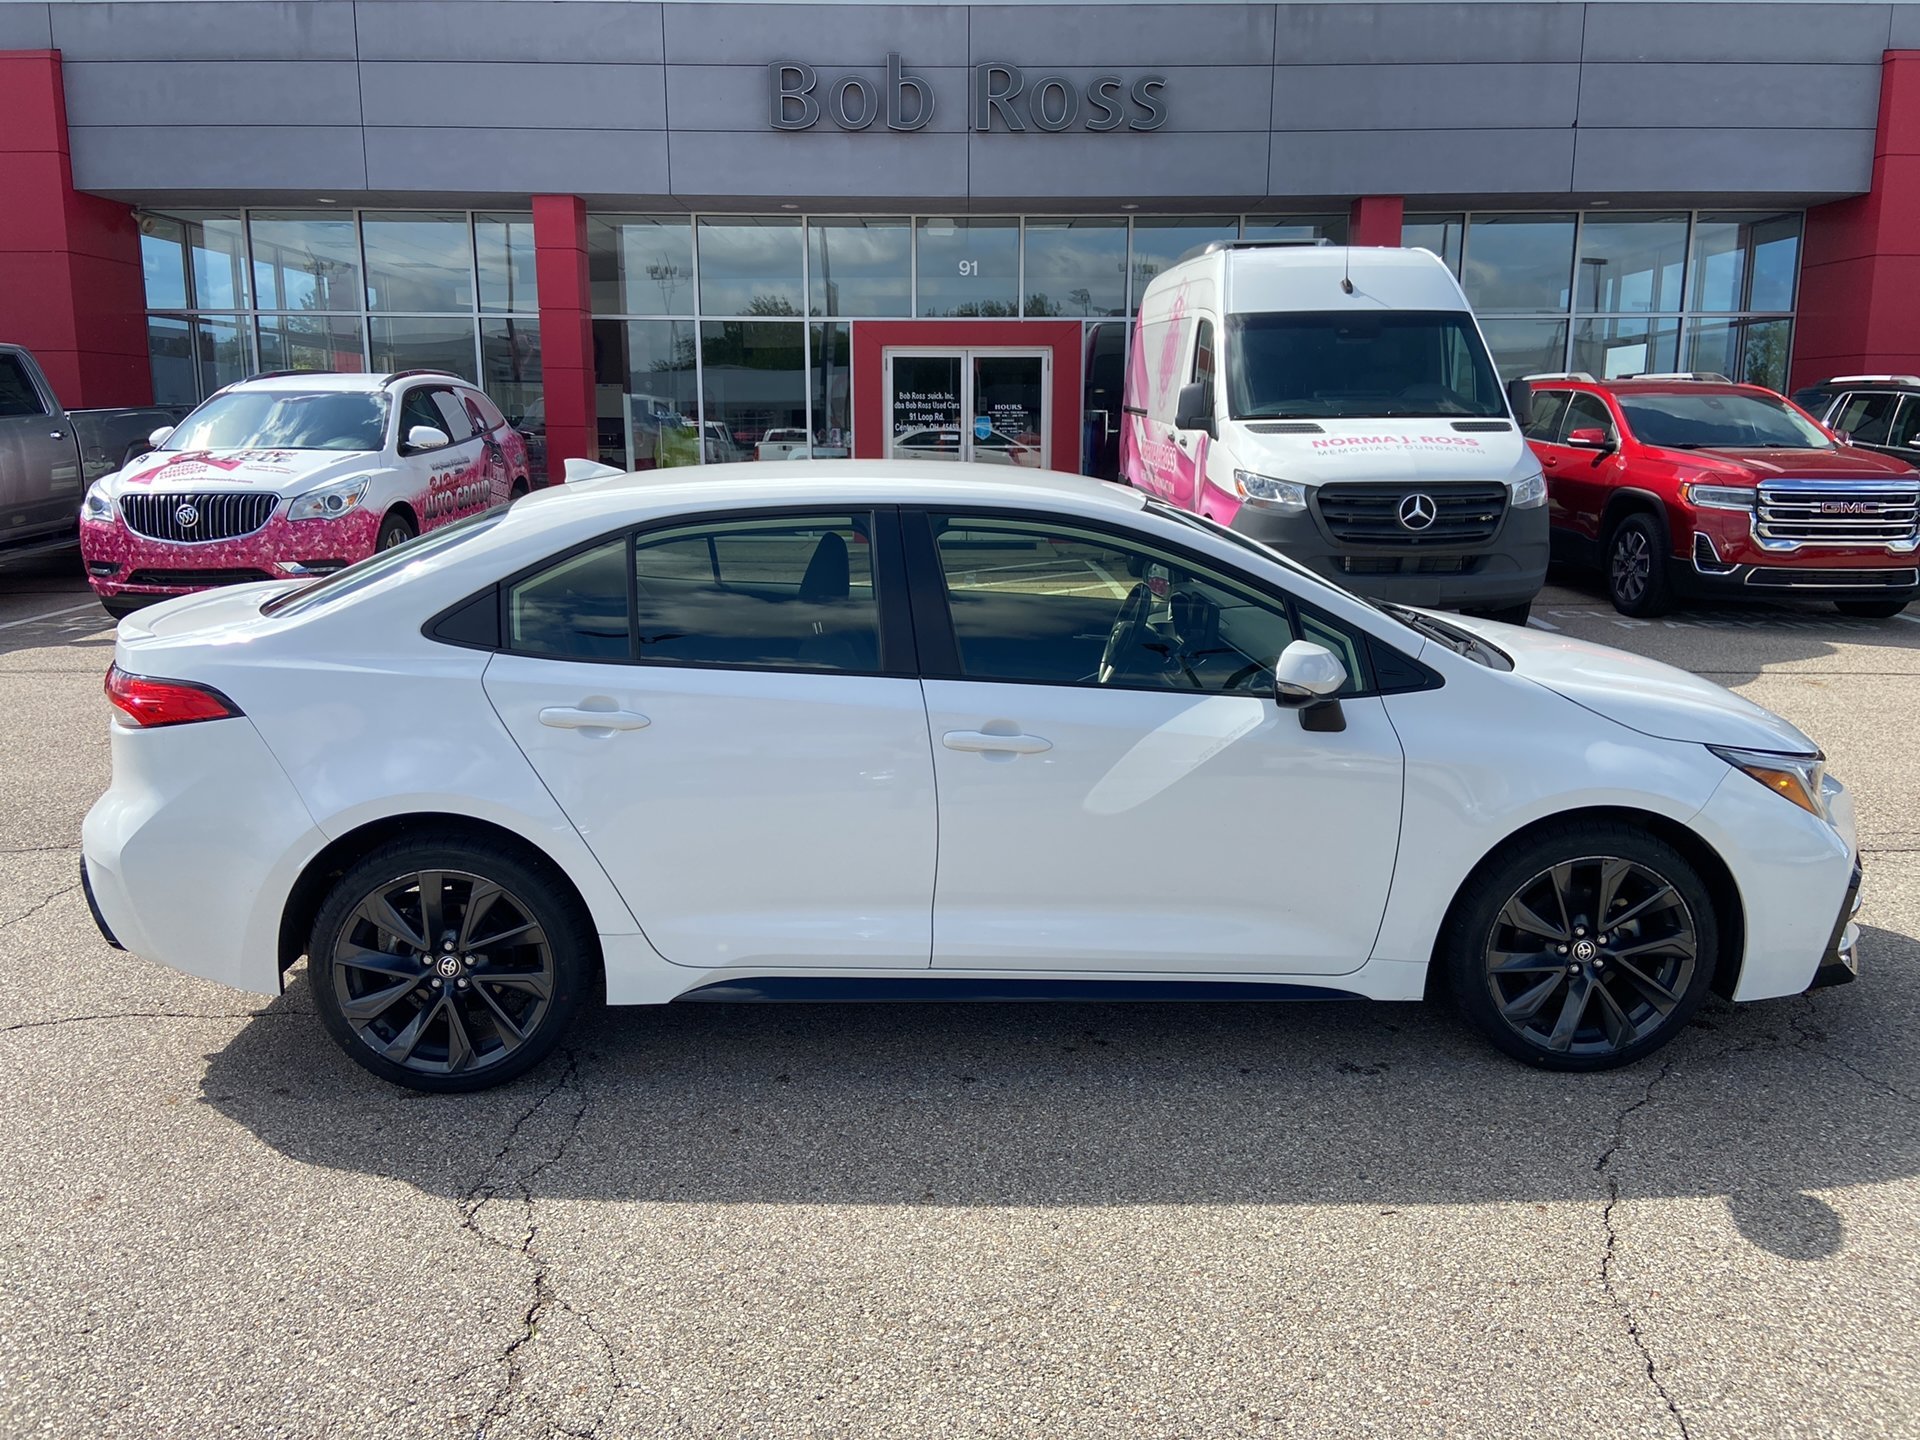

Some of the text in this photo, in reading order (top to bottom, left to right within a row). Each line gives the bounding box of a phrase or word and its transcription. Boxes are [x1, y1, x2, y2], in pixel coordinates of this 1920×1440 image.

[768, 53, 1169, 132] Bob Ross
[958, 259, 978, 276] 91
[899, 391, 911, 400] Bob
[911, 391, 926, 400] Ross
[894, 401, 960, 409] dba Bob Ross Used Cars
[909, 412, 917, 421] 91
[917, 412, 934, 423] Loop
[1312, 436, 1398, 448] NORMA
[1419, 436, 1480, 447] ROSS
[1317, 444, 1487, 457] MEMORIAL FOUNDATION
[424, 490, 454, 519] AUTO
[456, 479, 491, 511] GROUP
[1821, 501, 1879, 514] GMC
